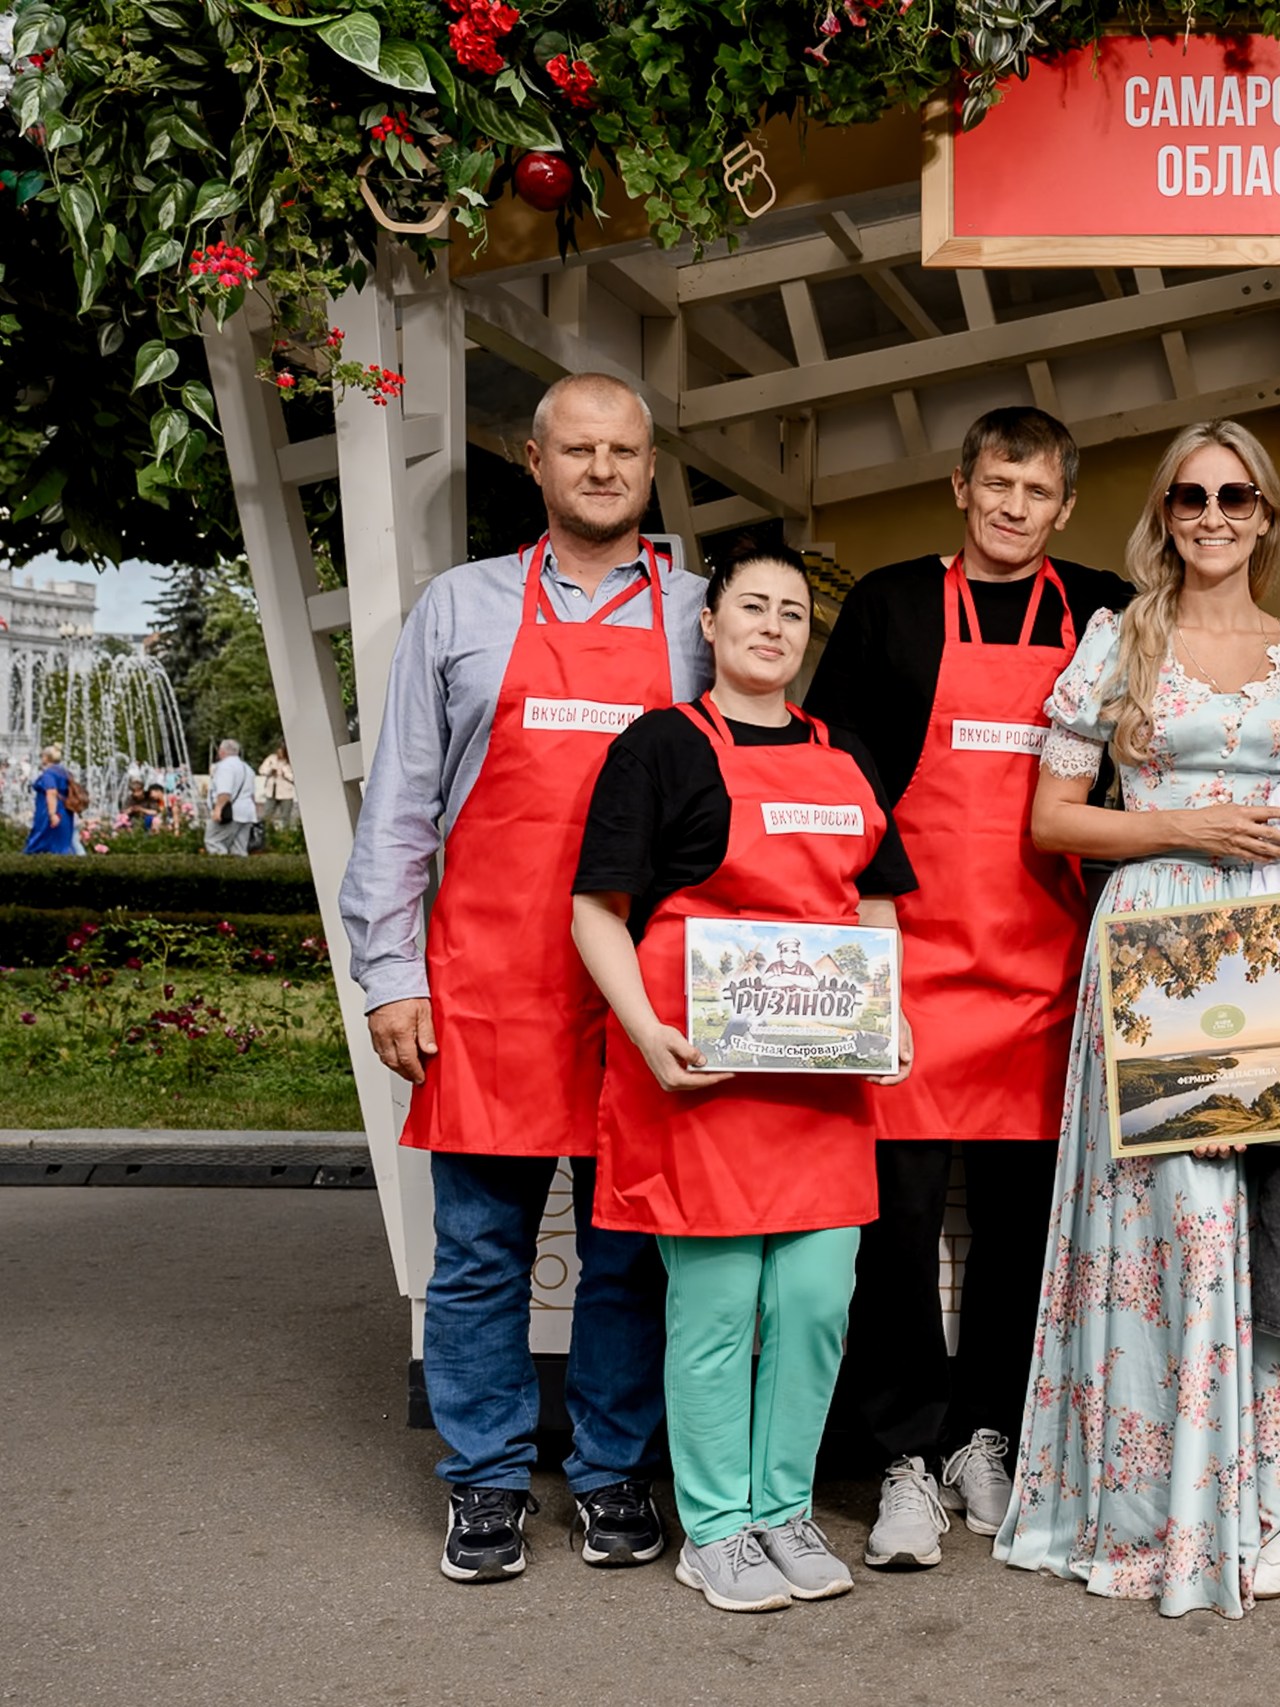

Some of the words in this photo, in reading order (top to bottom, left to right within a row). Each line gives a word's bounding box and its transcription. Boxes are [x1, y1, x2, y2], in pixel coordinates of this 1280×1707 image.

[531, 705, 577, 722] ВКУСЫ
[959, 727, 1001, 744] ВКУСЫ
[770, 809, 810, 826] ВКУСЫ
[813, 810, 859, 827] РОССИИ
[736, 988, 852, 1018] РУЗАНОВ
[731, 1034, 784, 1056] Частная
[786, 1043, 855, 1057] сыроварня
